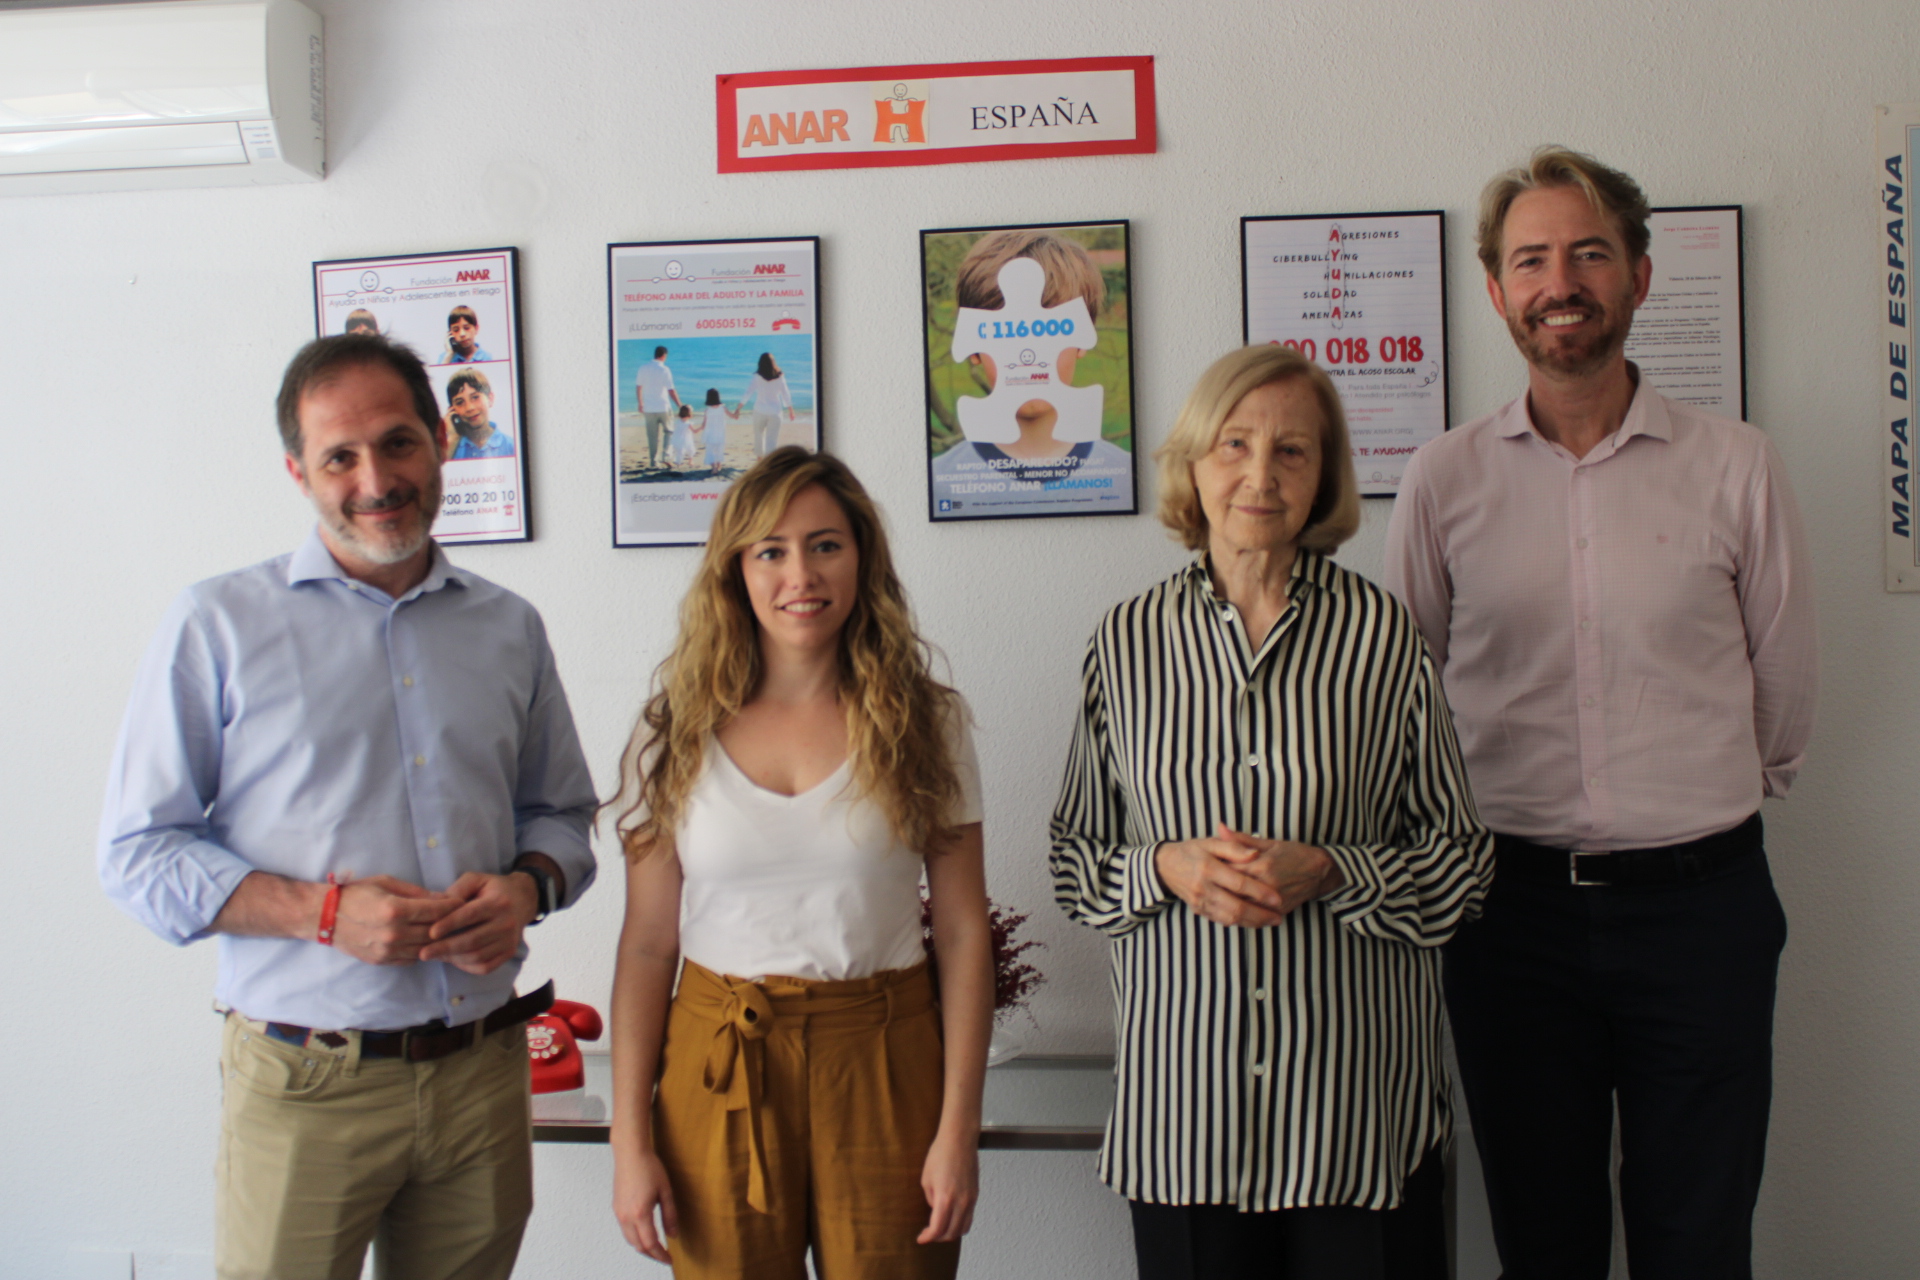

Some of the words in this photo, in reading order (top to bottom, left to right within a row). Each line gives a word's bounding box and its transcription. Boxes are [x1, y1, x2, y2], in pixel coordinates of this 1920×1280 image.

[741, 109, 851, 148] ANAR
[970, 97, 1100, 131] ESPAÑA
[1329, 229, 1400, 243] AGRESIONES
[1881, 154, 1906, 328] ESPAÑA
[1273, 249, 1359, 264] CIBERBULLYING
[711, 267, 750, 277] Fundación
[753, 263, 786, 275] ANAR
[1324, 269, 1415, 281] HUMILLACIONES
[410, 277, 452, 287] Fundación
[456, 269, 491, 283] ANAR
[328, 299, 357, 308] Ayuda
[367, 295, 391, 304] Niños
[391, 296, 398, 304] y
[399, 290, 457, 302] Adolescentes
[458, 289, 471, 297] en
[472, 286, 502, 297] Riesgo
[624, 292, 667, 303] TELÉFONO
[669, 292, 693, 301] ANAR
[696, 291, 710, 300] DEL
[713, 290, 746, 299] ADULTO
[749, 290, 755, 298] Y
[757, 290, 768, 298] LA
[770, 289, 804, 297] FAMILIA
[1303, 288, 1358, 300] SOLEDAD
[1302, 307, 1363, 321] AMENAZAS
[695, 318, 756, 330] 600505152
[1326, 337, 1370, 364] 018
[1380, 335, 1424, 363] 018
[1347, 368, 1357, 376] EL
[1358, 367, 1383, 376] ACOSO
[1384, 367, 1417, 376] ESCOLAR
[1889, 341, 1907, 401] DE
[1359, 447, 1370, 456] TE
[988, 456, 1078, 470] DESAPARECIDO?
[980, 470, 1018, 481] PARENTAL
[1024, 469, 1053, 479] MENOR
[1055, 468, 1068, 478] NO
[1890, 417, 1910, 538] MAPA
[950, 480, 1006, 495] TELÉFONO
[1009, 480, 1041, 493] ANAR
[464, 492, 479, 504] 20
[482, 491, 497, 502] 20
[501, 490, 515, 502] 10
